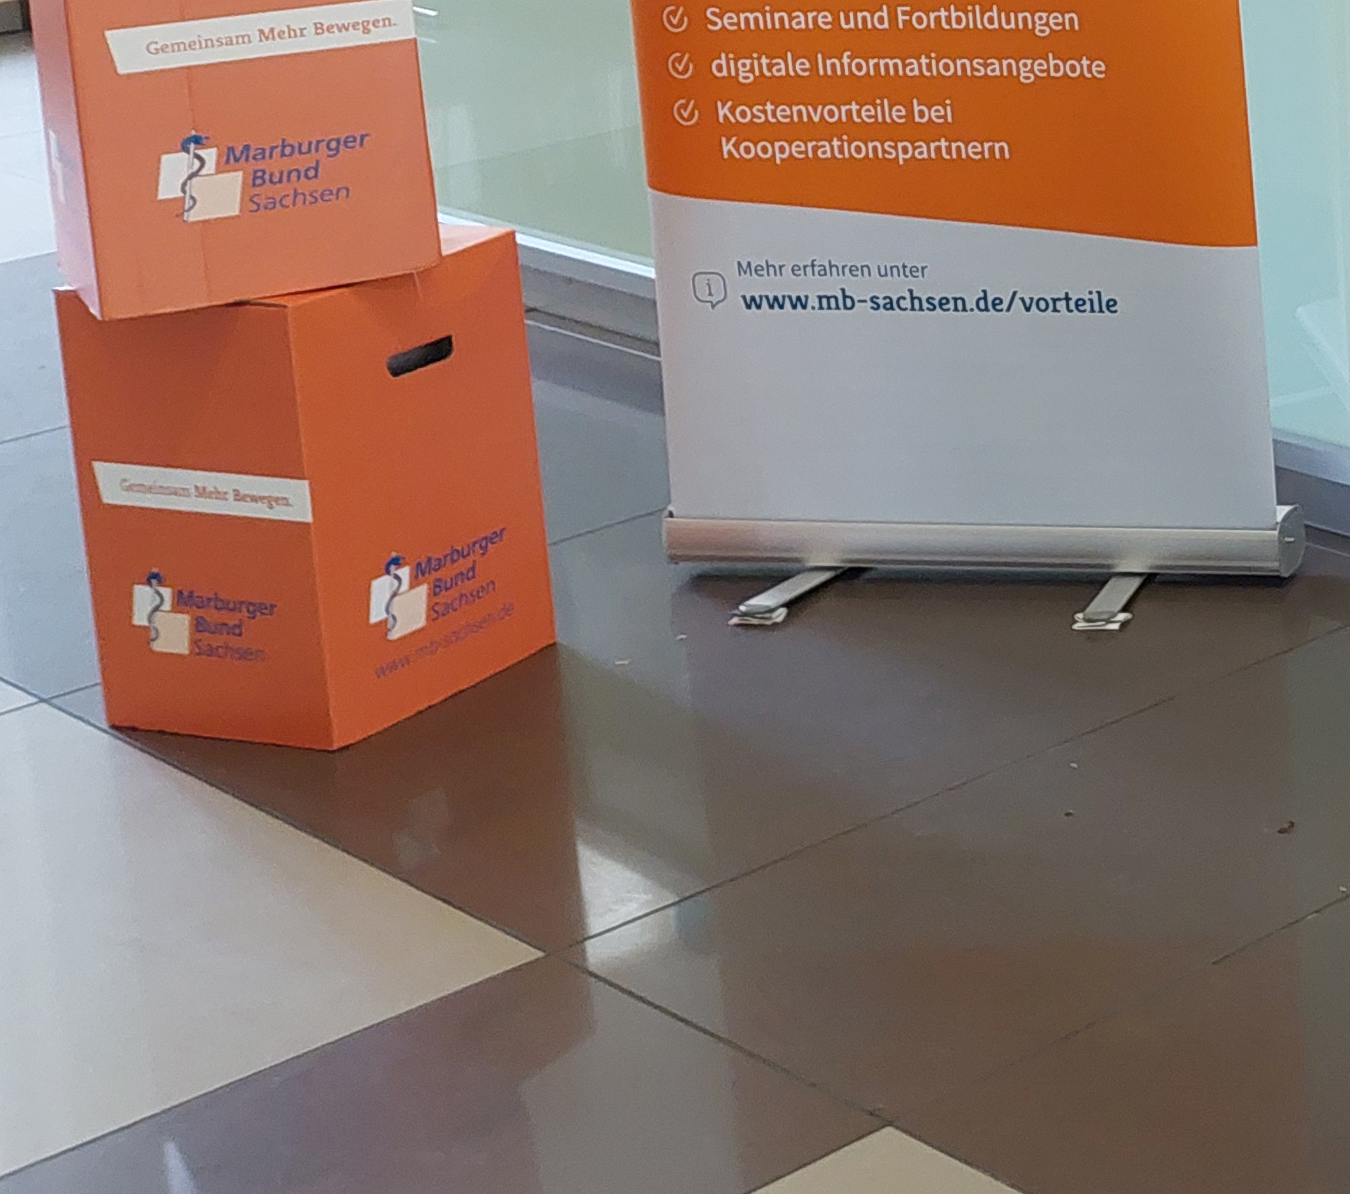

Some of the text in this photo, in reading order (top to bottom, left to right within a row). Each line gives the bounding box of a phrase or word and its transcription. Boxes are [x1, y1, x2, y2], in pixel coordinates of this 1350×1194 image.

[146, 15, 398, 56] Gemeinsam Mehr Bewegen.
[705, 5, 1080, 37] Seminare und Fortbildungen
[711, 51, 1107, 83] digitale Informationsangebote
[717, 99, 953, 124] Kostenvorteile bei
[224, 133, 370, 165] Marburger
[721, 135, 1010, 164] Kooperationspartnern
[252, 160, 320, 188] Bund
[249, 184, 351, 213] Sachsen
[737, 259, 928, 279] Mehr erfahren unter
[741, 288, 1118, 314] www.mb-sachsen.de/vorteile
[414, 527, 507, 580] Marburger
[432, 560, 477, 597] Bund
[176, 590, 278, 619] Marburger
[431, 580, 496, 621] Sachsen
